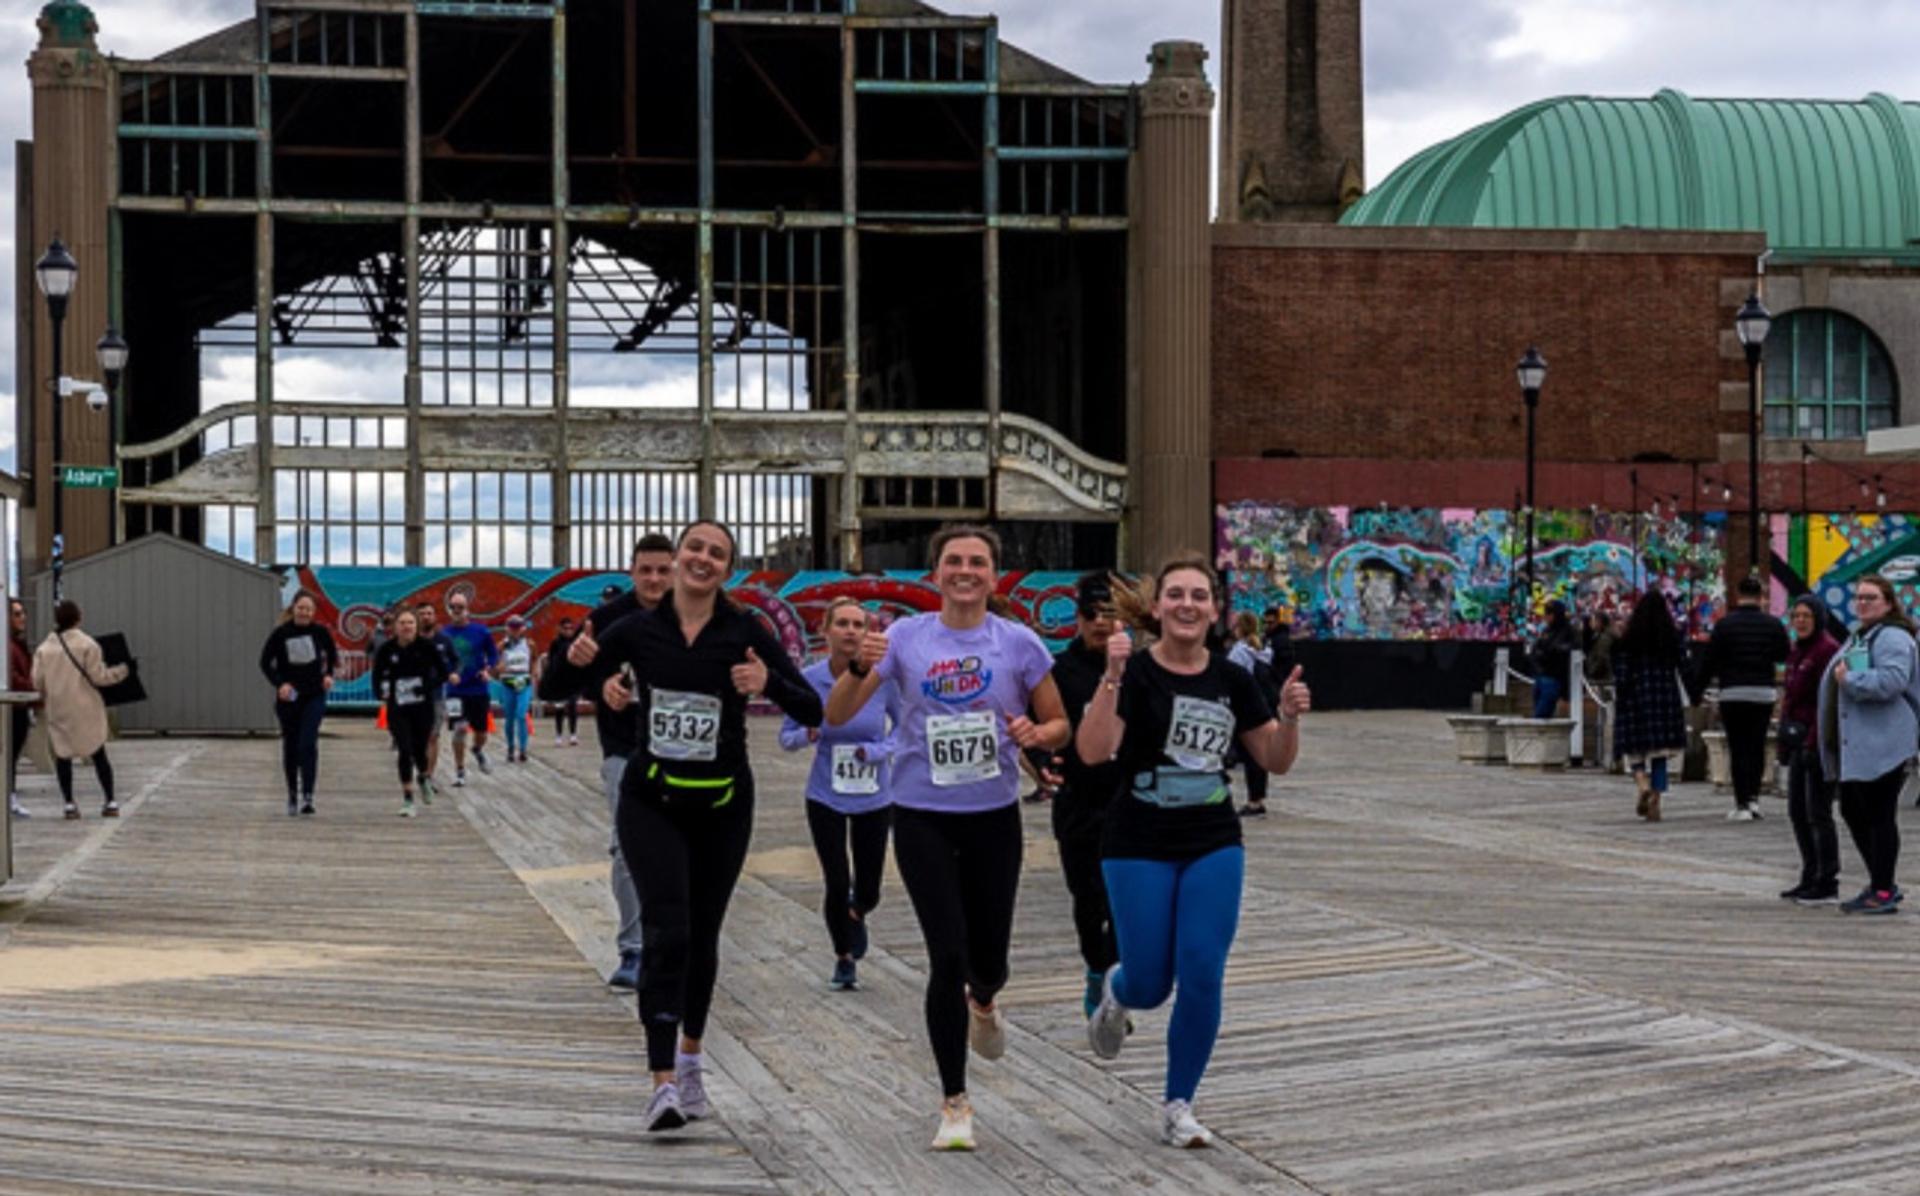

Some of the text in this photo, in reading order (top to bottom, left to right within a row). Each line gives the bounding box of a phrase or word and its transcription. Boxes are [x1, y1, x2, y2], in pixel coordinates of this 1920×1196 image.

[66, 469, 103, 486] Asbury
[653, 711, 715, 742] 5332
[932, 733, 997, 766] 6679
